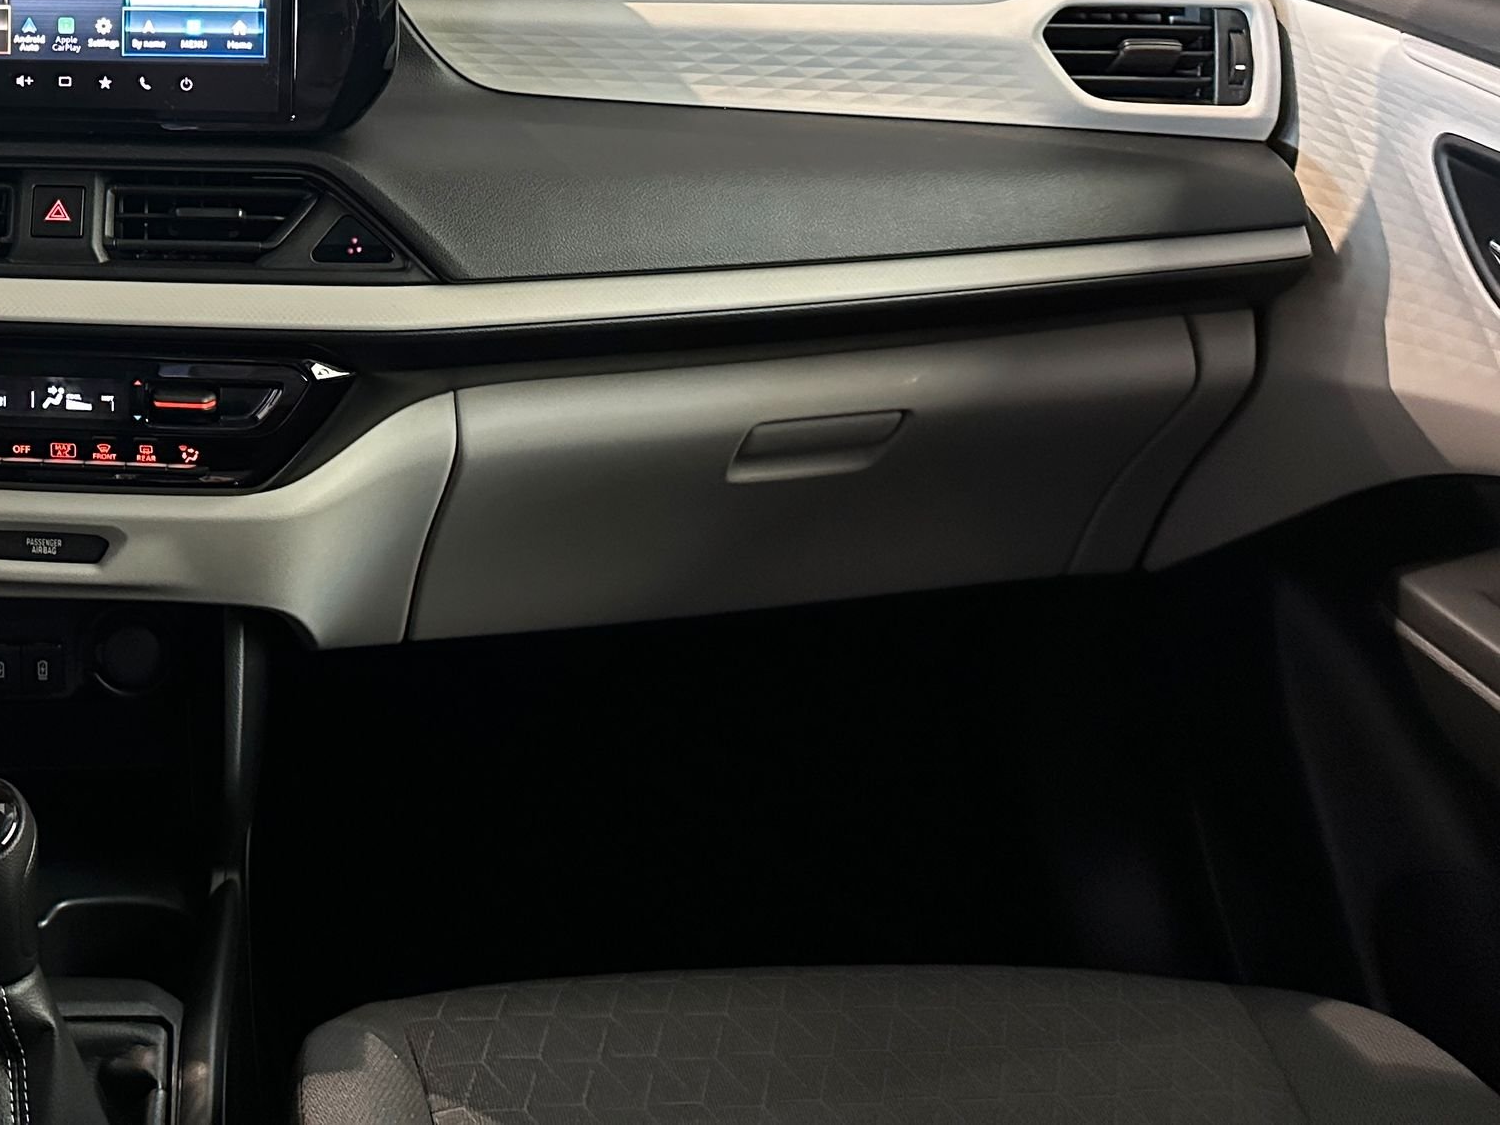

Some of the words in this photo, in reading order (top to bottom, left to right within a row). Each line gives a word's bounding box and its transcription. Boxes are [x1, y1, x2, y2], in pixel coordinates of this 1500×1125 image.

[13, 35, 46, 44] Android
[55, 36, 78, 45] Apple
[87, 38, 120, 50] Settings
[180, 39, 207, 49] MENU
[19, 43, 40, 52] Auto
[52, 43, 82, 53] CarPlay
[227, 40, 253, 50] Home
[12, 444, 31, 454] OFF
[92, 453, 117, 461] FRONT
[136, 454, 156, 462] REAR
[26, 537, 62, 548] PASSENGER
[31, 546, 57, 555] AIRBAG
